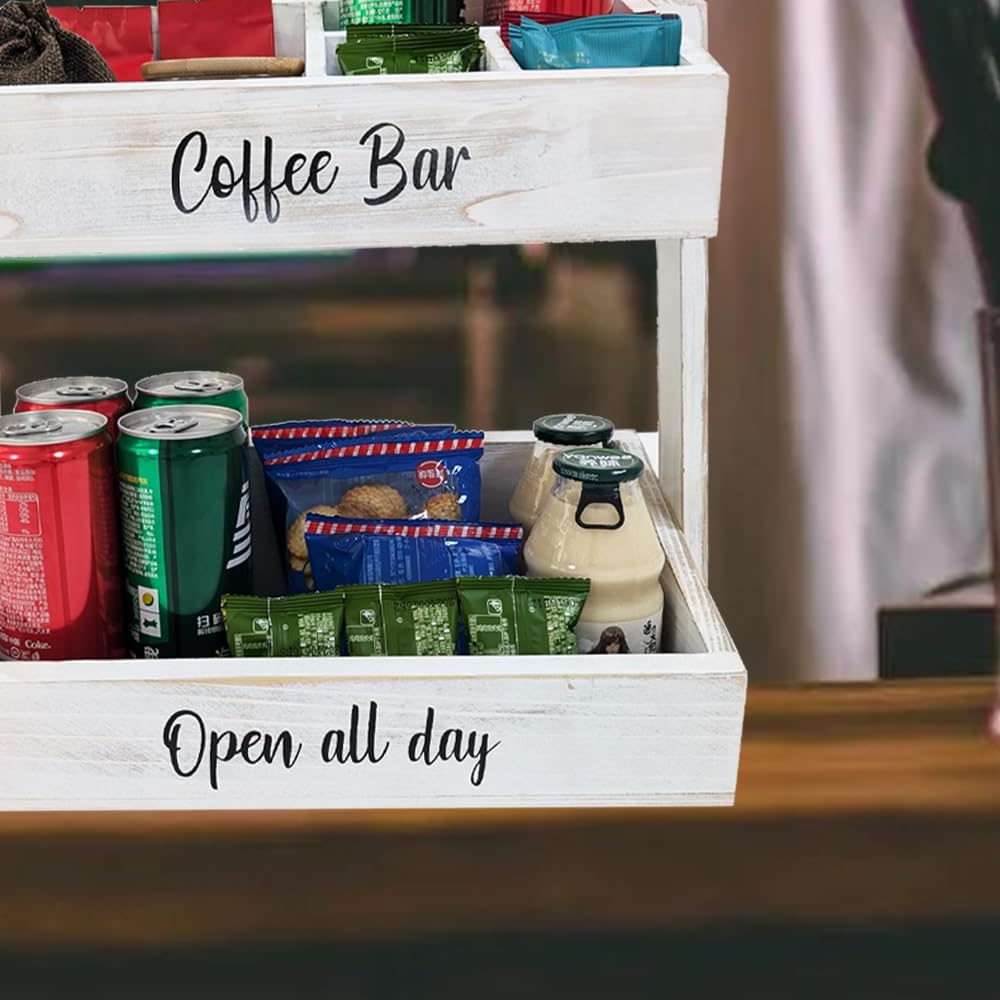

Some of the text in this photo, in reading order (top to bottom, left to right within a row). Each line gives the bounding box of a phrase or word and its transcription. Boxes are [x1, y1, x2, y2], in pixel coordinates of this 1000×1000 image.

[171, 121, 471, 223] Coffee Bar
[162, 700, 500, 790] Open all day
